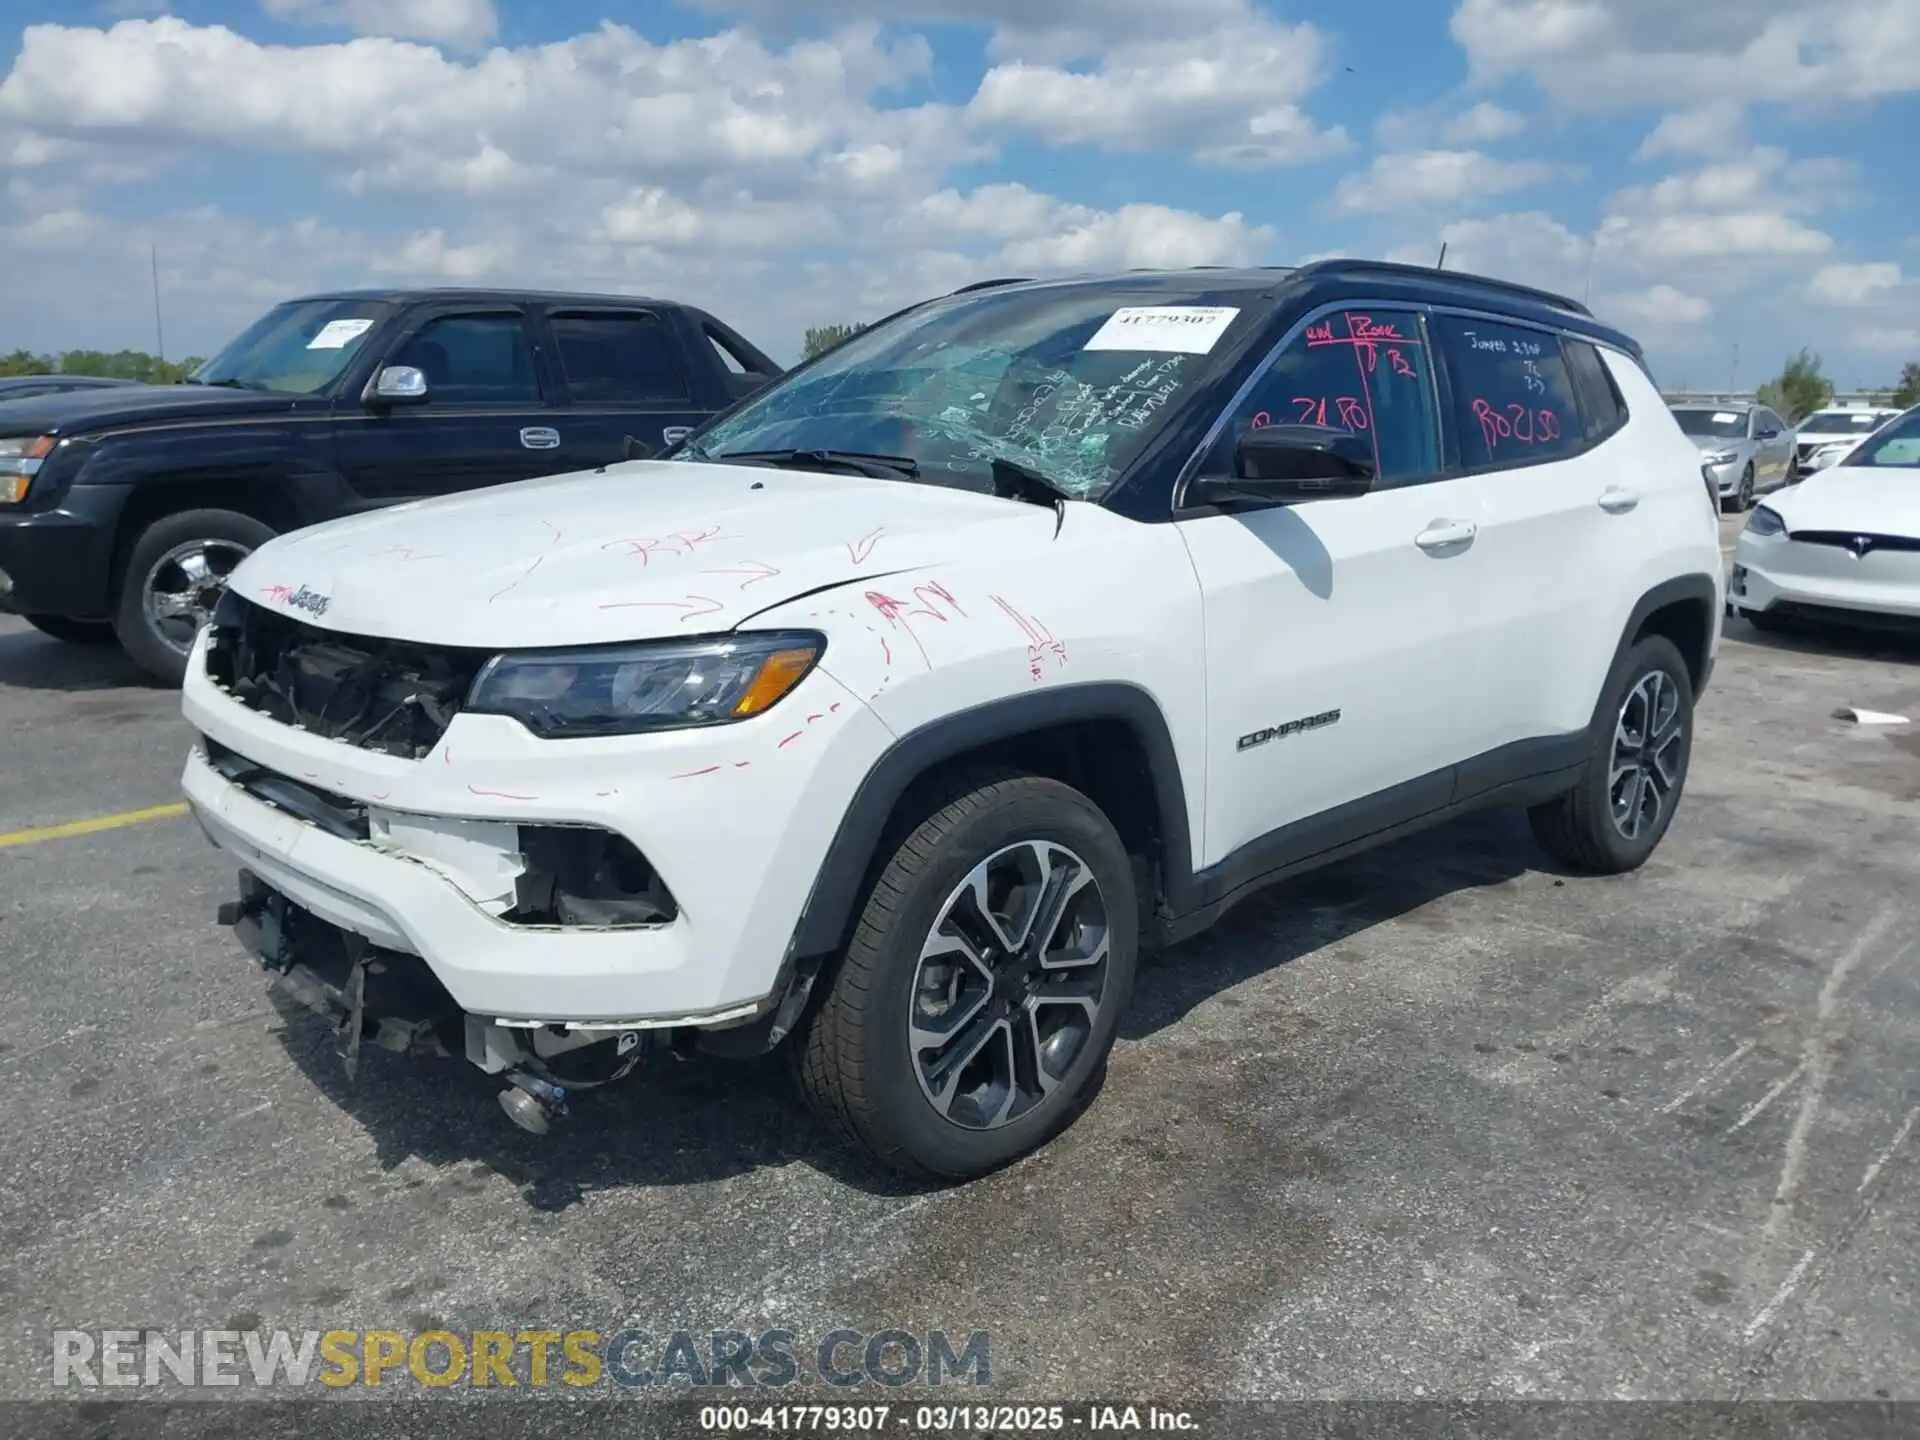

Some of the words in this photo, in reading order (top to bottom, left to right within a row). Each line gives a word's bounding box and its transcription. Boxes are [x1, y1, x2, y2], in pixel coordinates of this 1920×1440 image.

[1119, 315, 1217, 325] 41779307
[288, 583, 331, 619] Jeep
[1237, 708, 1342, 752] COMPASS
